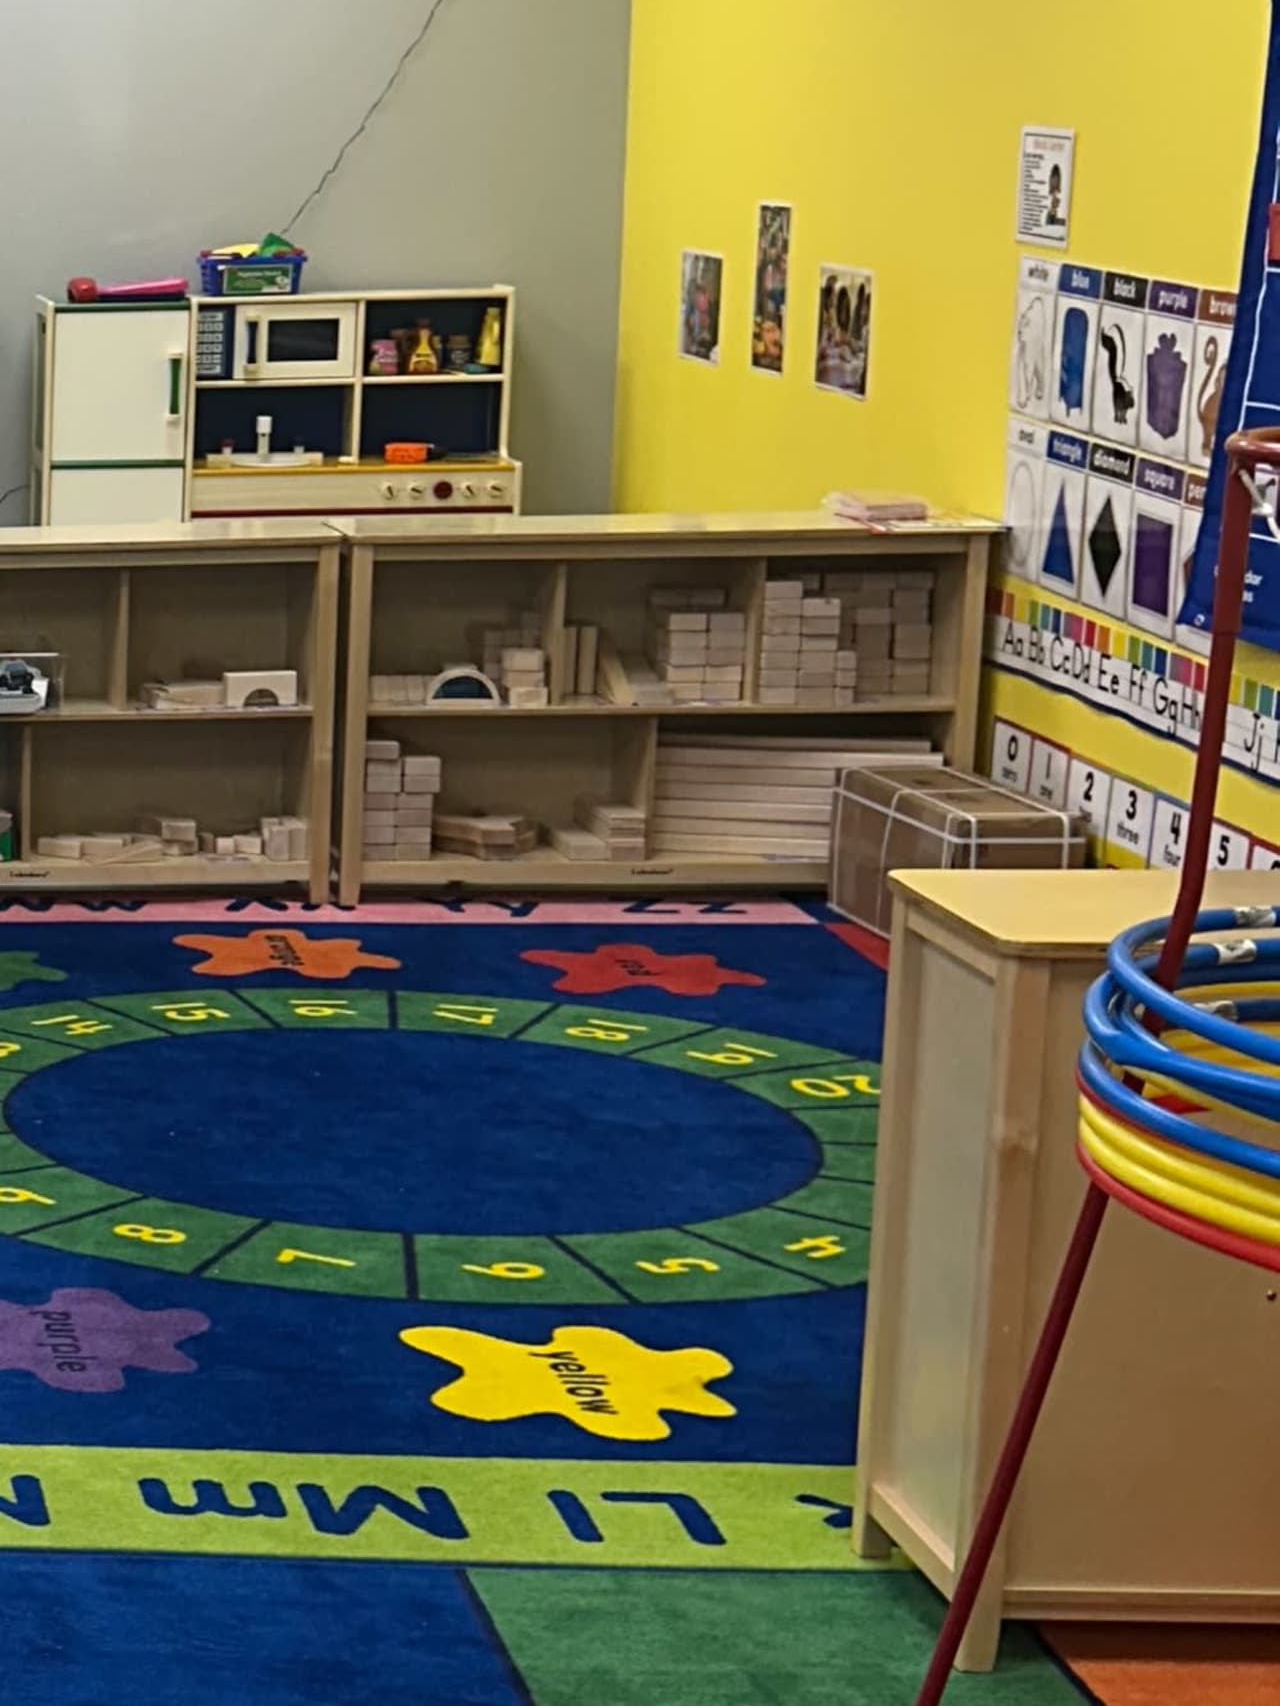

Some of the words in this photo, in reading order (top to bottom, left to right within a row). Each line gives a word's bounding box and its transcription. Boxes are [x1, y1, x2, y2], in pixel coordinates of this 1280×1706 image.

[1071, 269, 1090, 289] blue
[1113, 277, 1136, 299] black
[1157, 291, 1188, 311] purple
[1209, 295, 1237, 316] brow
[1052, 438, 1082, 462] triangle
[1094, 449, 1130, 475] diamond
[1144, 468, 1175, 490] square
[1097, 653, 1120, 695] Ee
[1129, 663, 1148, 705] Ff
[1153, 677, 1178, 736] Gg
[1244, 713, 1265, 772] Jj
[1007, 735, 1018, 762] 0
[1083, 771, 1094, 801] 2
[1126, 790, 1137, 820] 3
[1170, 811, 1181, 845] 4
[1217, 835, 1230, 865] 5
[151, 1001, 231, 1020] 15
[289, 999, 356, 1018] 16
[433, 1003, 498, 1026] 17
[32, 1014, 113, 1036] 14
[564, 1018, 648, 1042] 18
[686, 1042, 778, 1066] 19
[790, 1073, 881, 1099] 20
[112, 1223, 187, 1245] 8
[276, 1247, 356, 1269] 7
[784, 1234, 847, 1259] 4
[461, 1260, 546, 1281] 6
[635, 1256, 720, 1276] 5
[37, 1307, 88, 1375] purple
[529, 1349, 620, 1418] yellow
[138, 1477, 470, 1540] Mm
[547, 1489, 728, 1547] Ll
